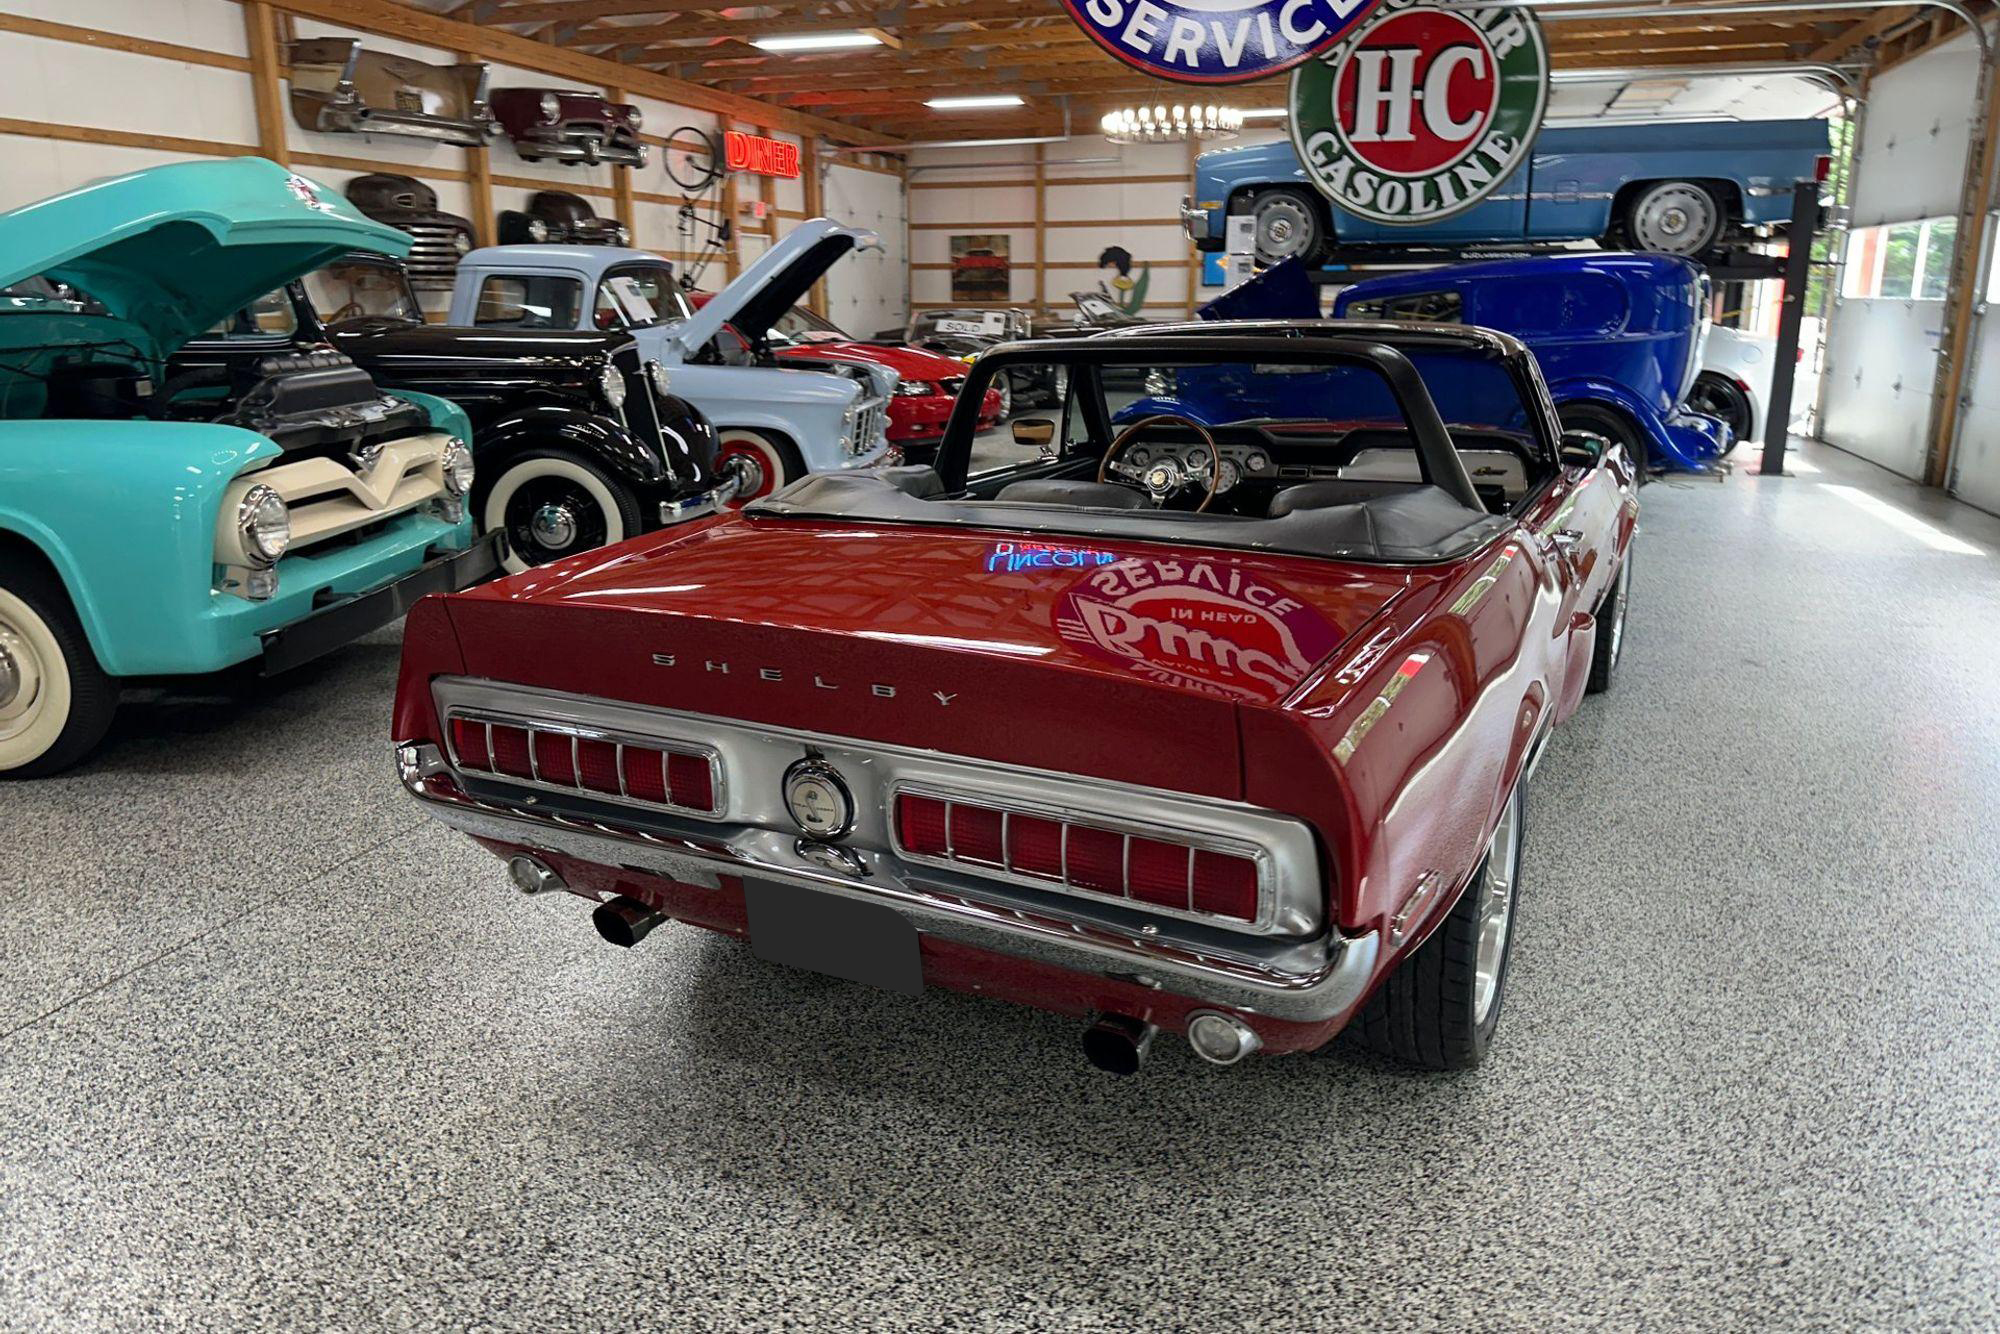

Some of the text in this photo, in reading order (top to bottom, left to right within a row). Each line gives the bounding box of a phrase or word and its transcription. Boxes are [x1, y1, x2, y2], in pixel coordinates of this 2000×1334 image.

[725, 130, 801, 179] DINER
[1305, 130, 1521, 215] GASOLINE
[945, 321, 981, 333] SOLD
[652, 652, 958, 706] SHELBY
